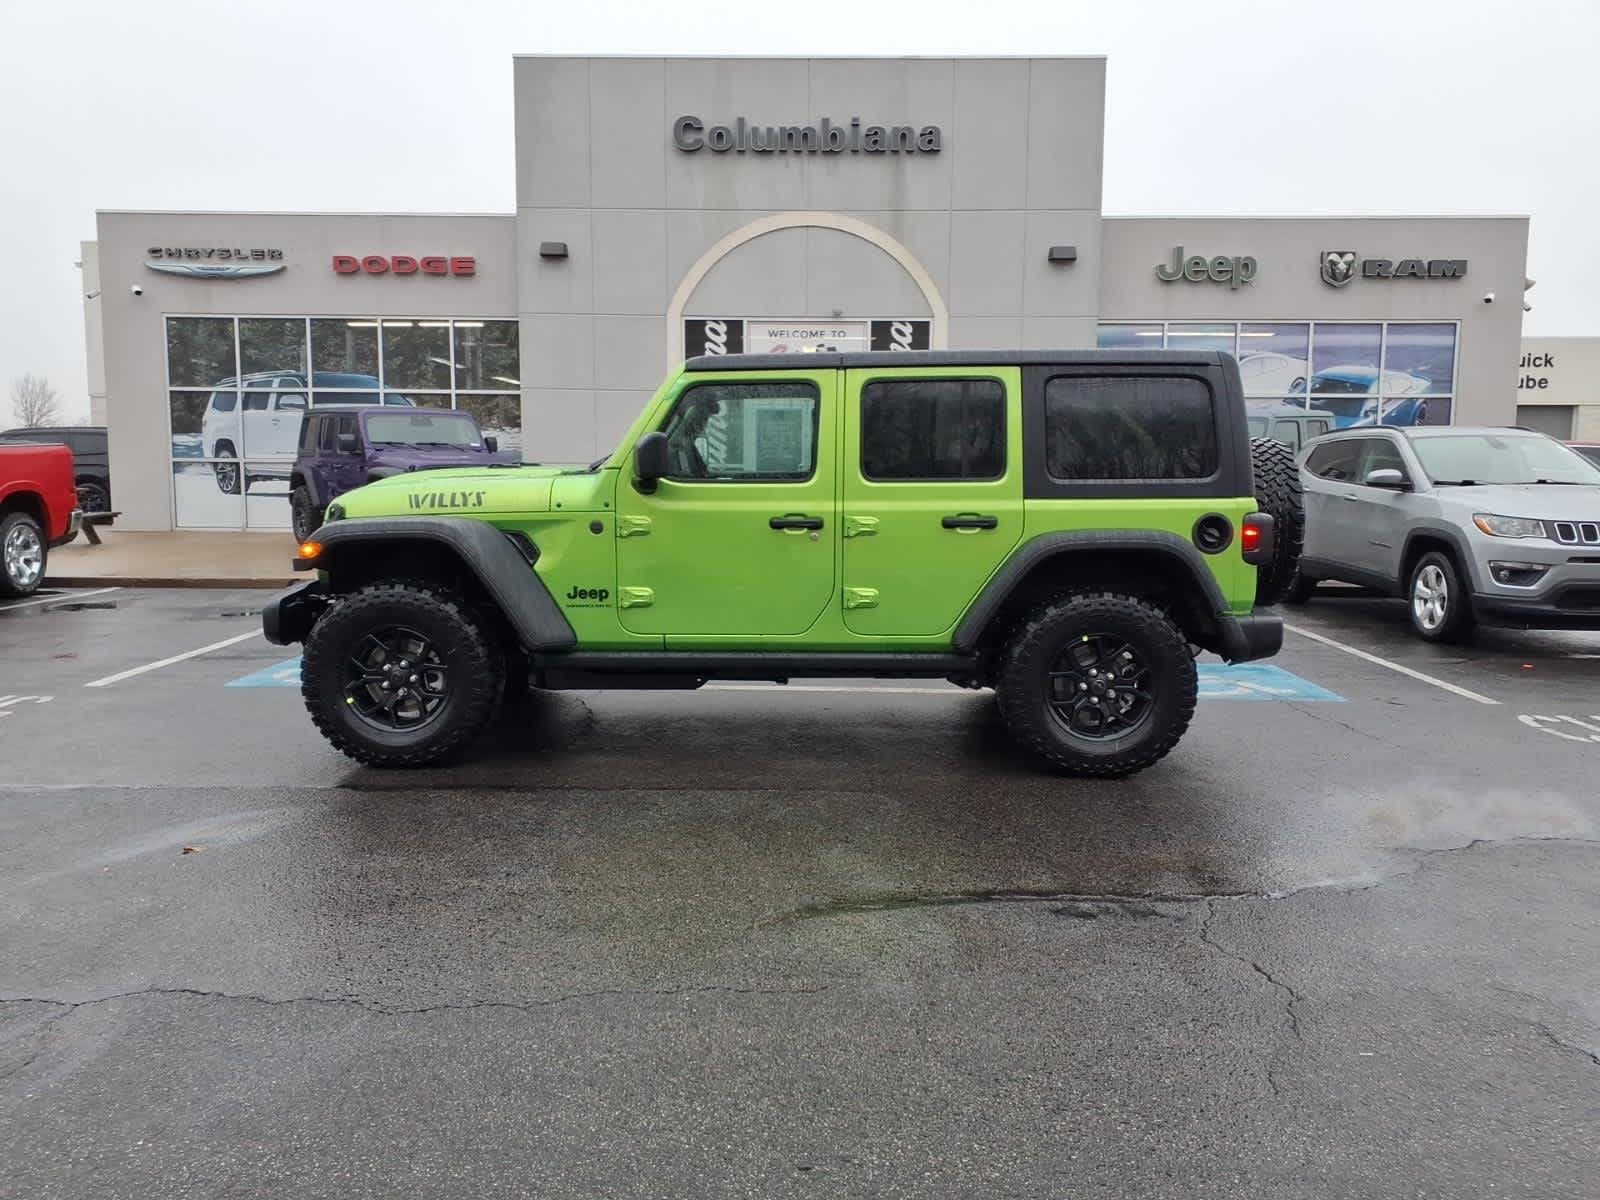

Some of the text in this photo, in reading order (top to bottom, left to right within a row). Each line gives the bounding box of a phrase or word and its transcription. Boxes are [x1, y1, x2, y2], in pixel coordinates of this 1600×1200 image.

[673, 115, 942, 154] Columbiana
[147, 247, 283, 260] CHRYSLER
[332, 255, 476, 275] DODGE
[1156, 246, 1258, 290] Jeep
[1362, 259, 1468, 279] RAM
[768, 329, 847, 339] WELCOME TO
[408, 491, 487, 509] WILLYS
[566, 585, 609, 602] Jeep
